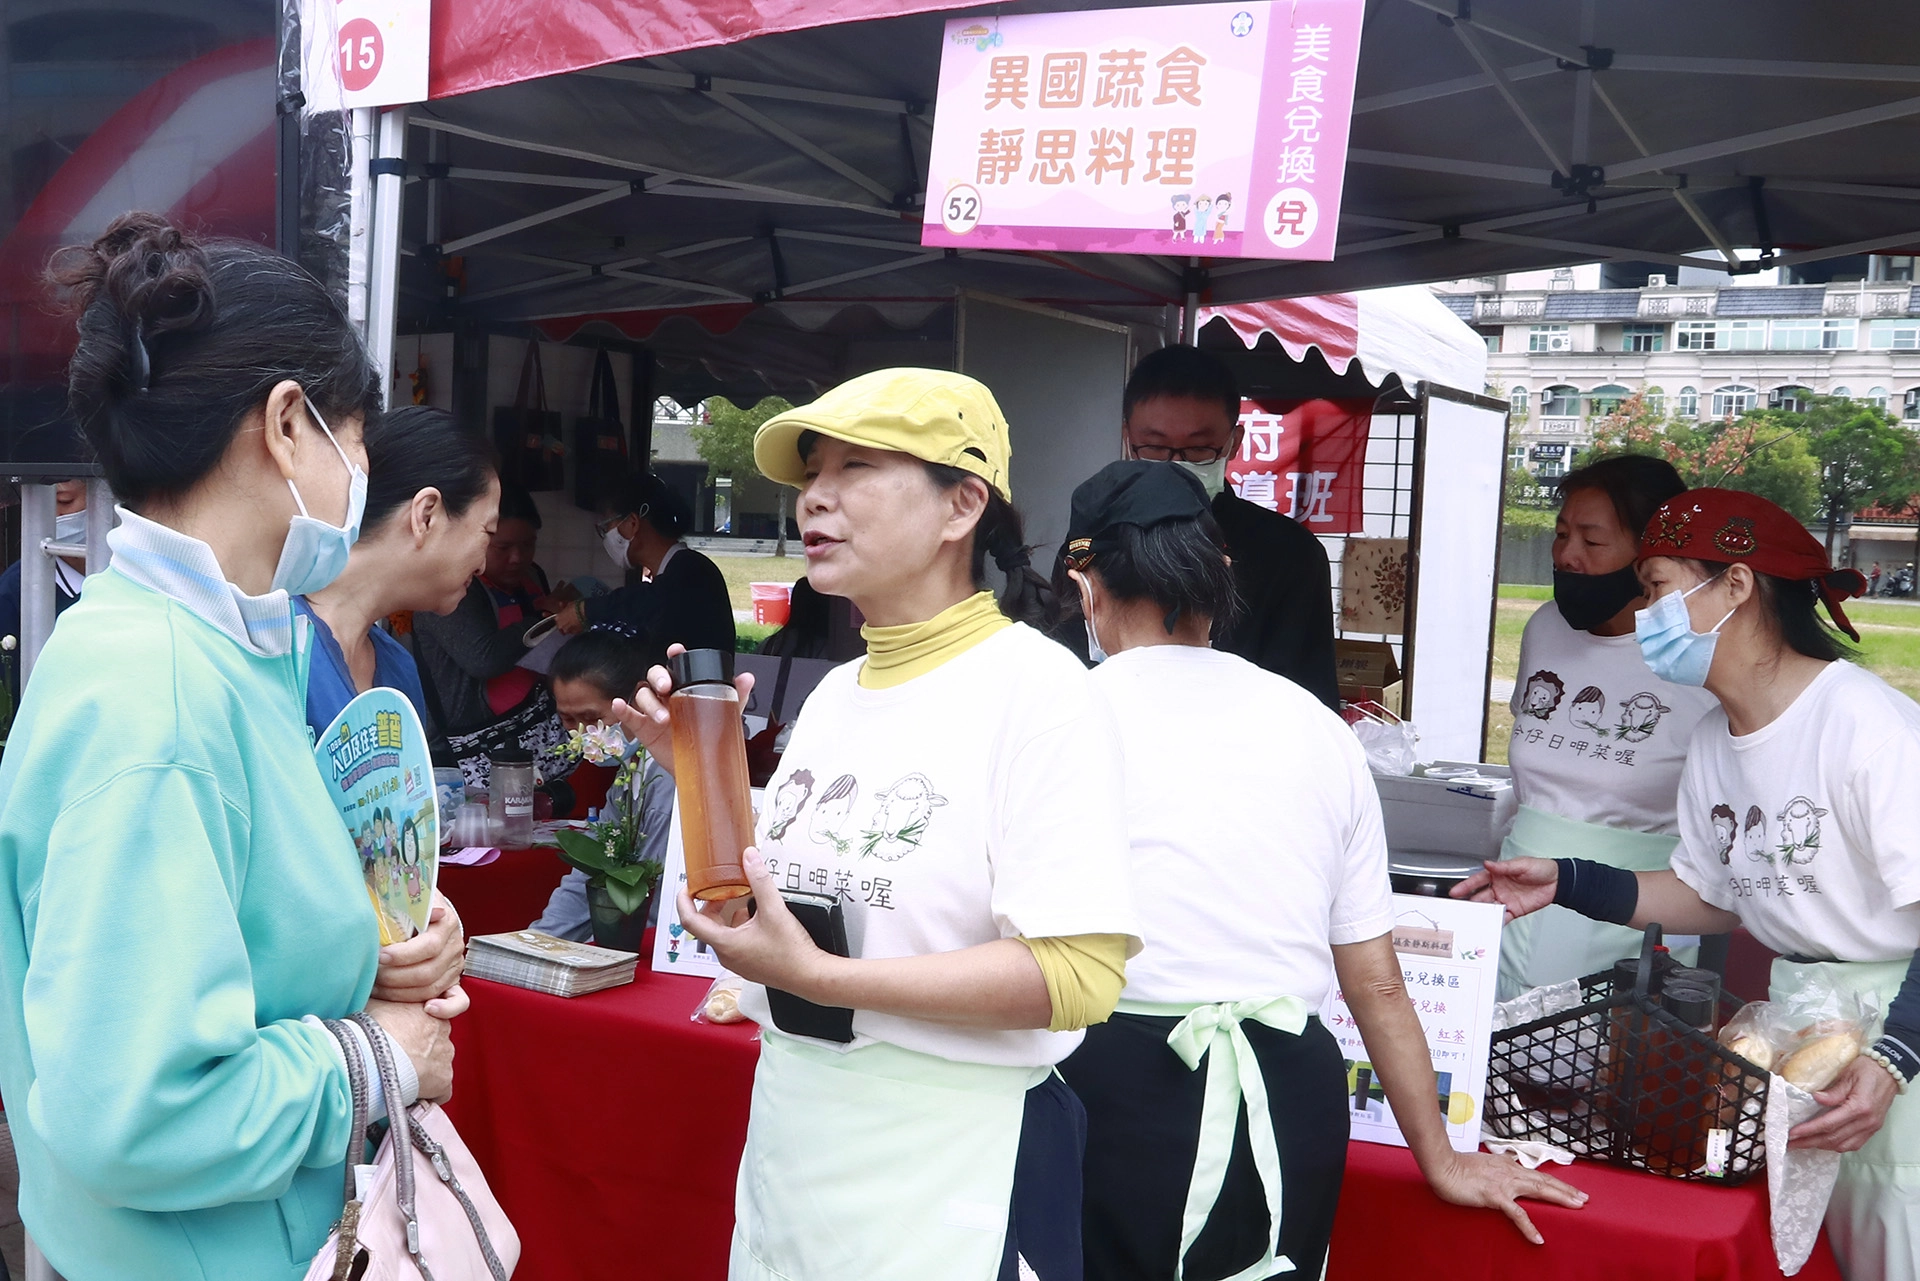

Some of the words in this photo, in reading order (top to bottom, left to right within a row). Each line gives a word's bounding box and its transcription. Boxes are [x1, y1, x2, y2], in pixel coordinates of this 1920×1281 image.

[340, 36, 376, 72] 15
[984, 46, 1207, 111] 異國蔬食
[1277, 23, 1332, 184] 美食兌換
[976, 126, 1198, 186] 靜思料理
[948, 196, 977, 222] 52
[1273, 200, 1308, 236] 兌
[1437, 1028, 1466, 1042] 紅茶
